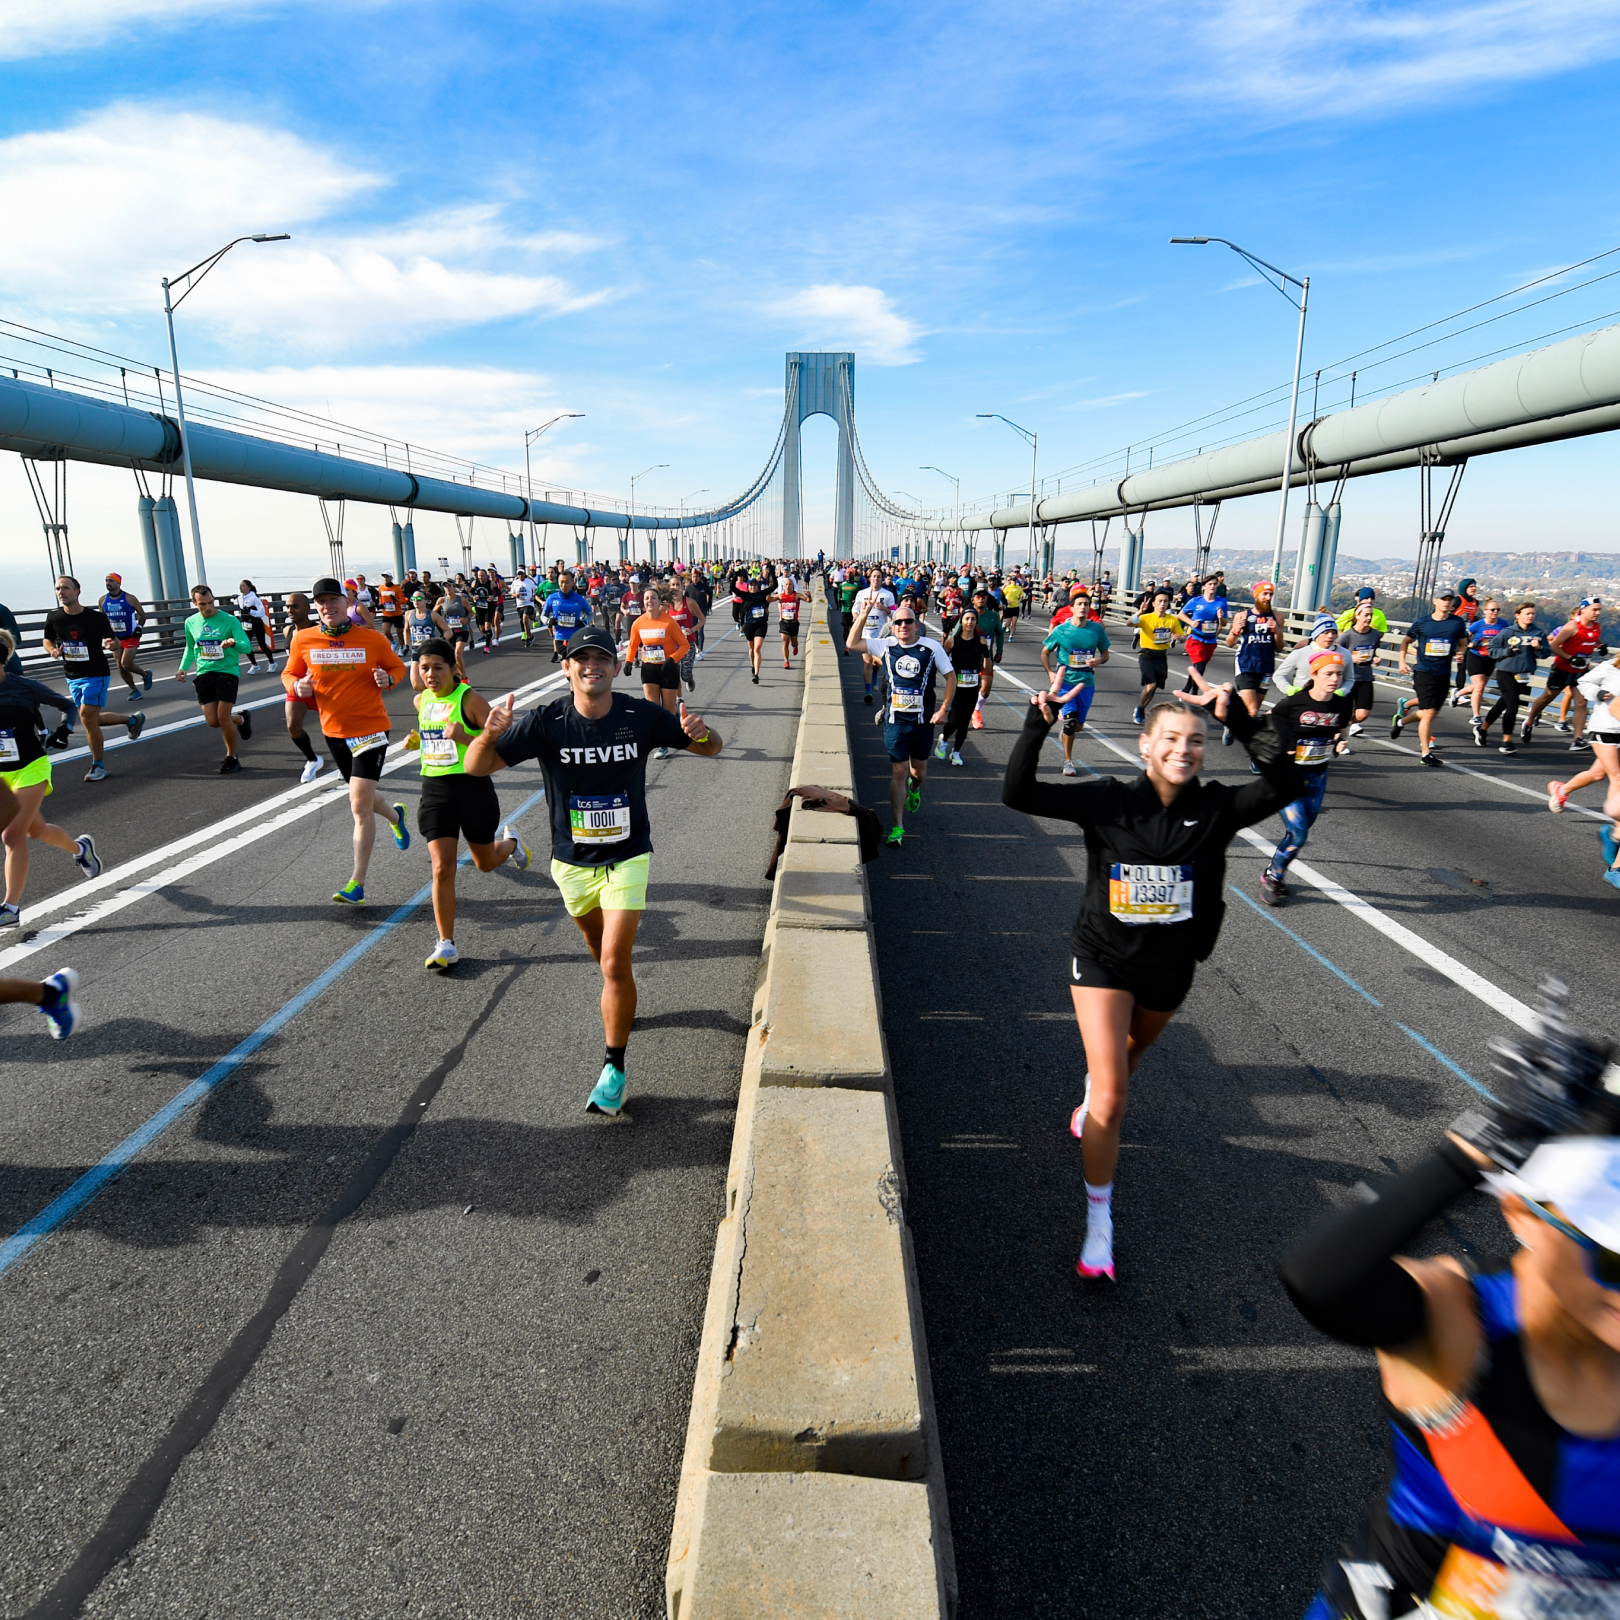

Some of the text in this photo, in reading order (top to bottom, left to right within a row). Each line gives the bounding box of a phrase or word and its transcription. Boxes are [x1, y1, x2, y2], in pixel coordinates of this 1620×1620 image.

[559, 742, 639, 764] STEVEN
[577, 799, 591, 809] tcs
[590, 810, 616, 828] 10011
[1123, 866, 1178, 882] MOLLY
[1134, 884, 1175, 903] 13397
